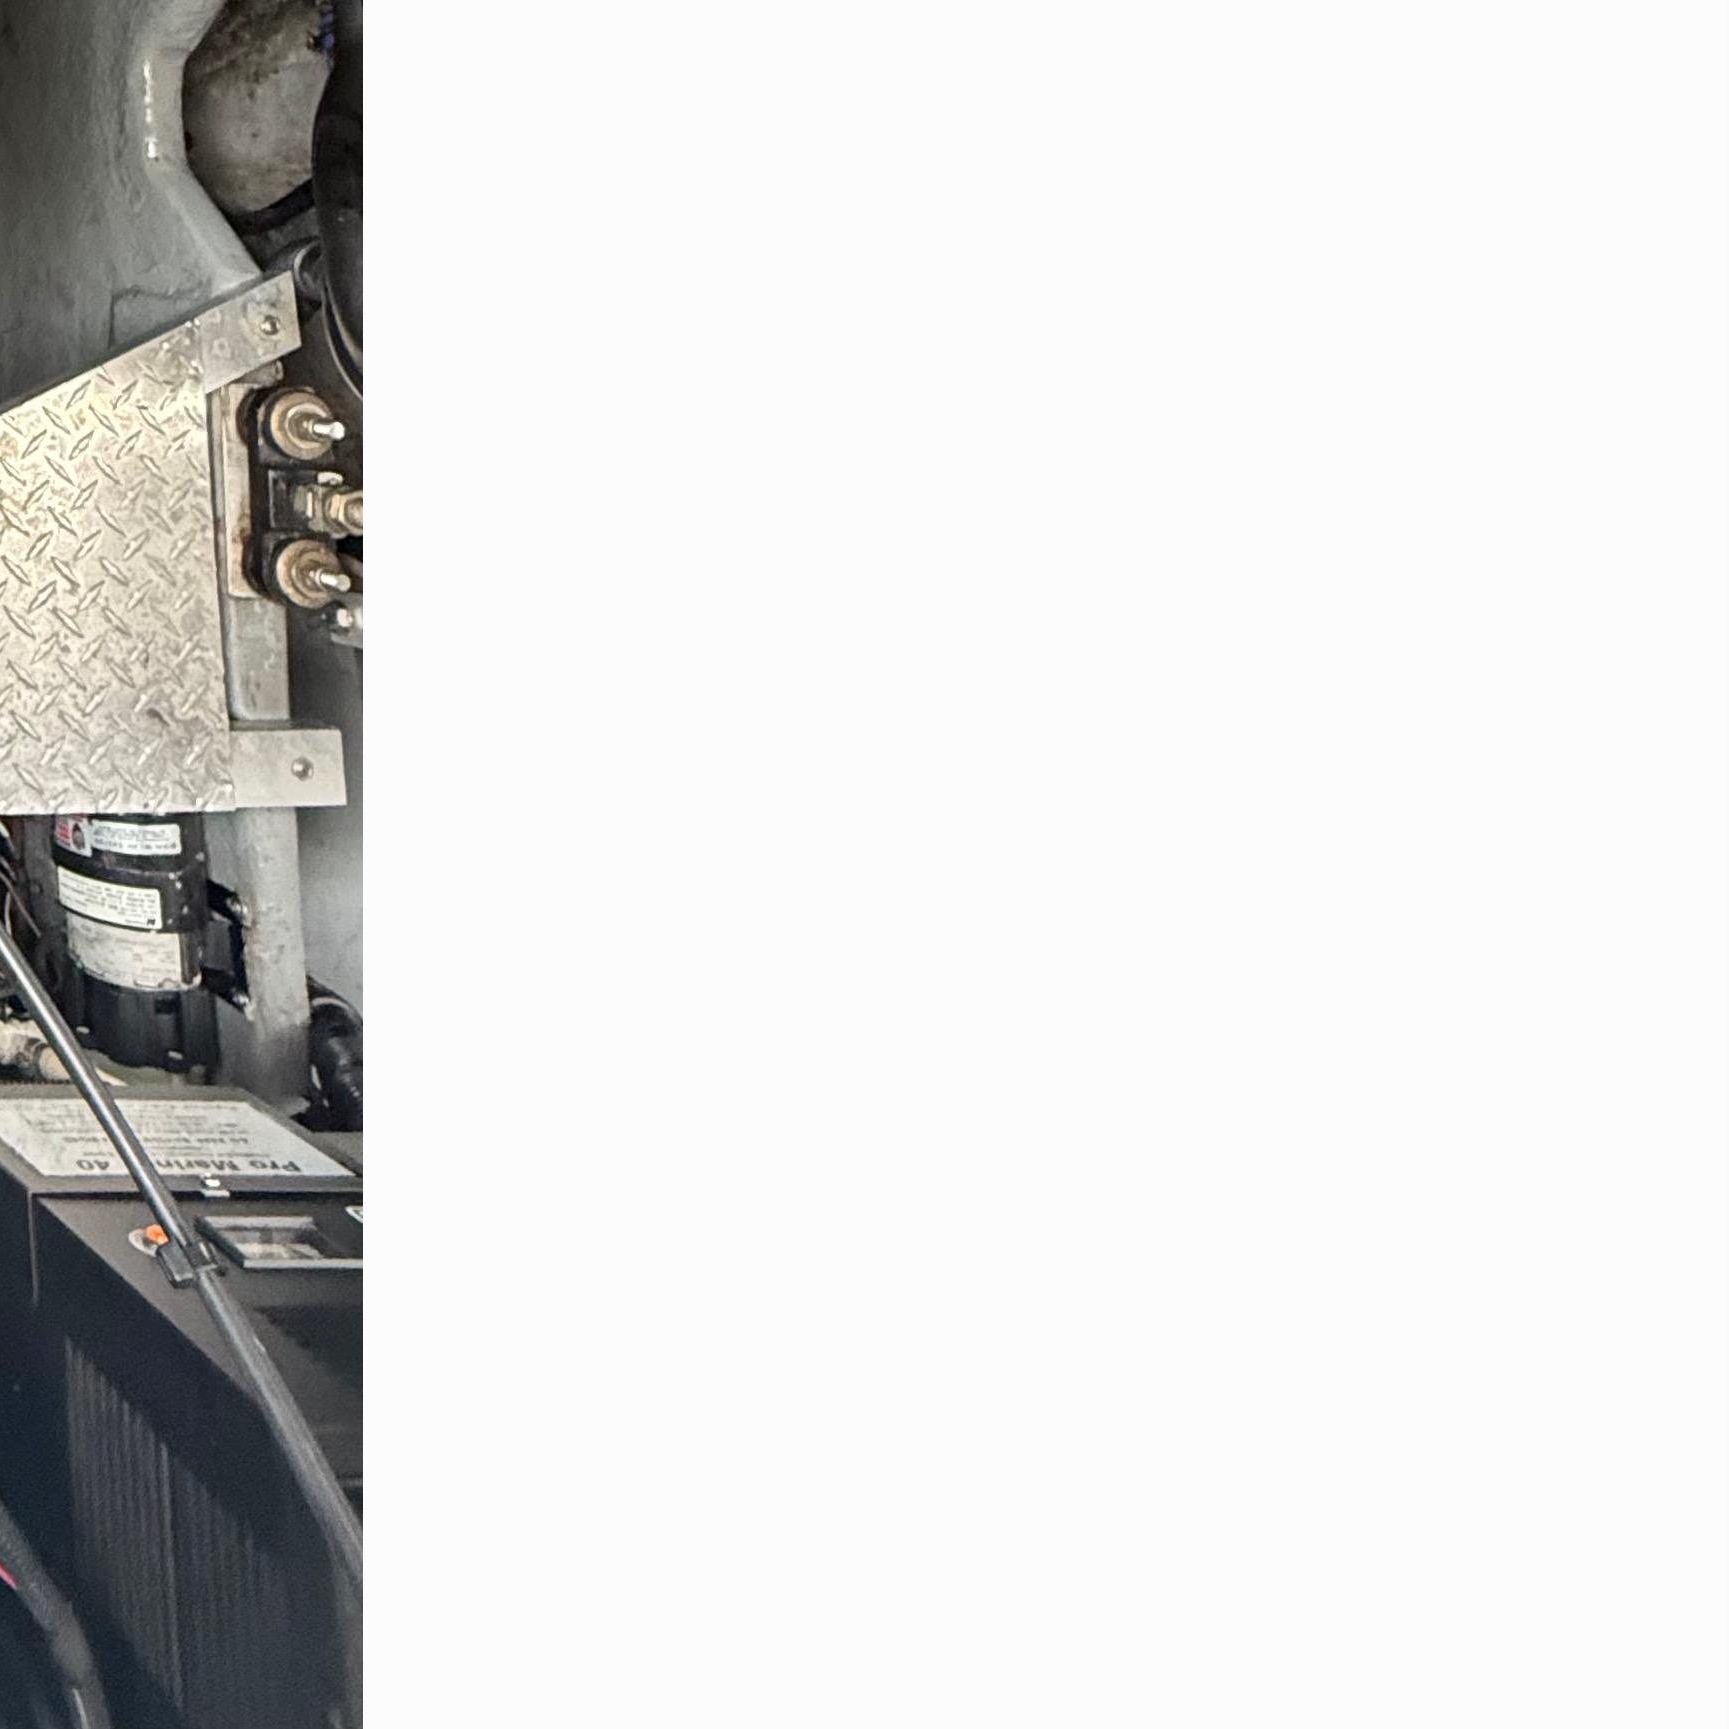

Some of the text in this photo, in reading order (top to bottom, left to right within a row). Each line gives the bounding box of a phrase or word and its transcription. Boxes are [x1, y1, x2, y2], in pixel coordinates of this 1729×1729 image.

[75, 1159, 301, 1173] Pro Marin 40
